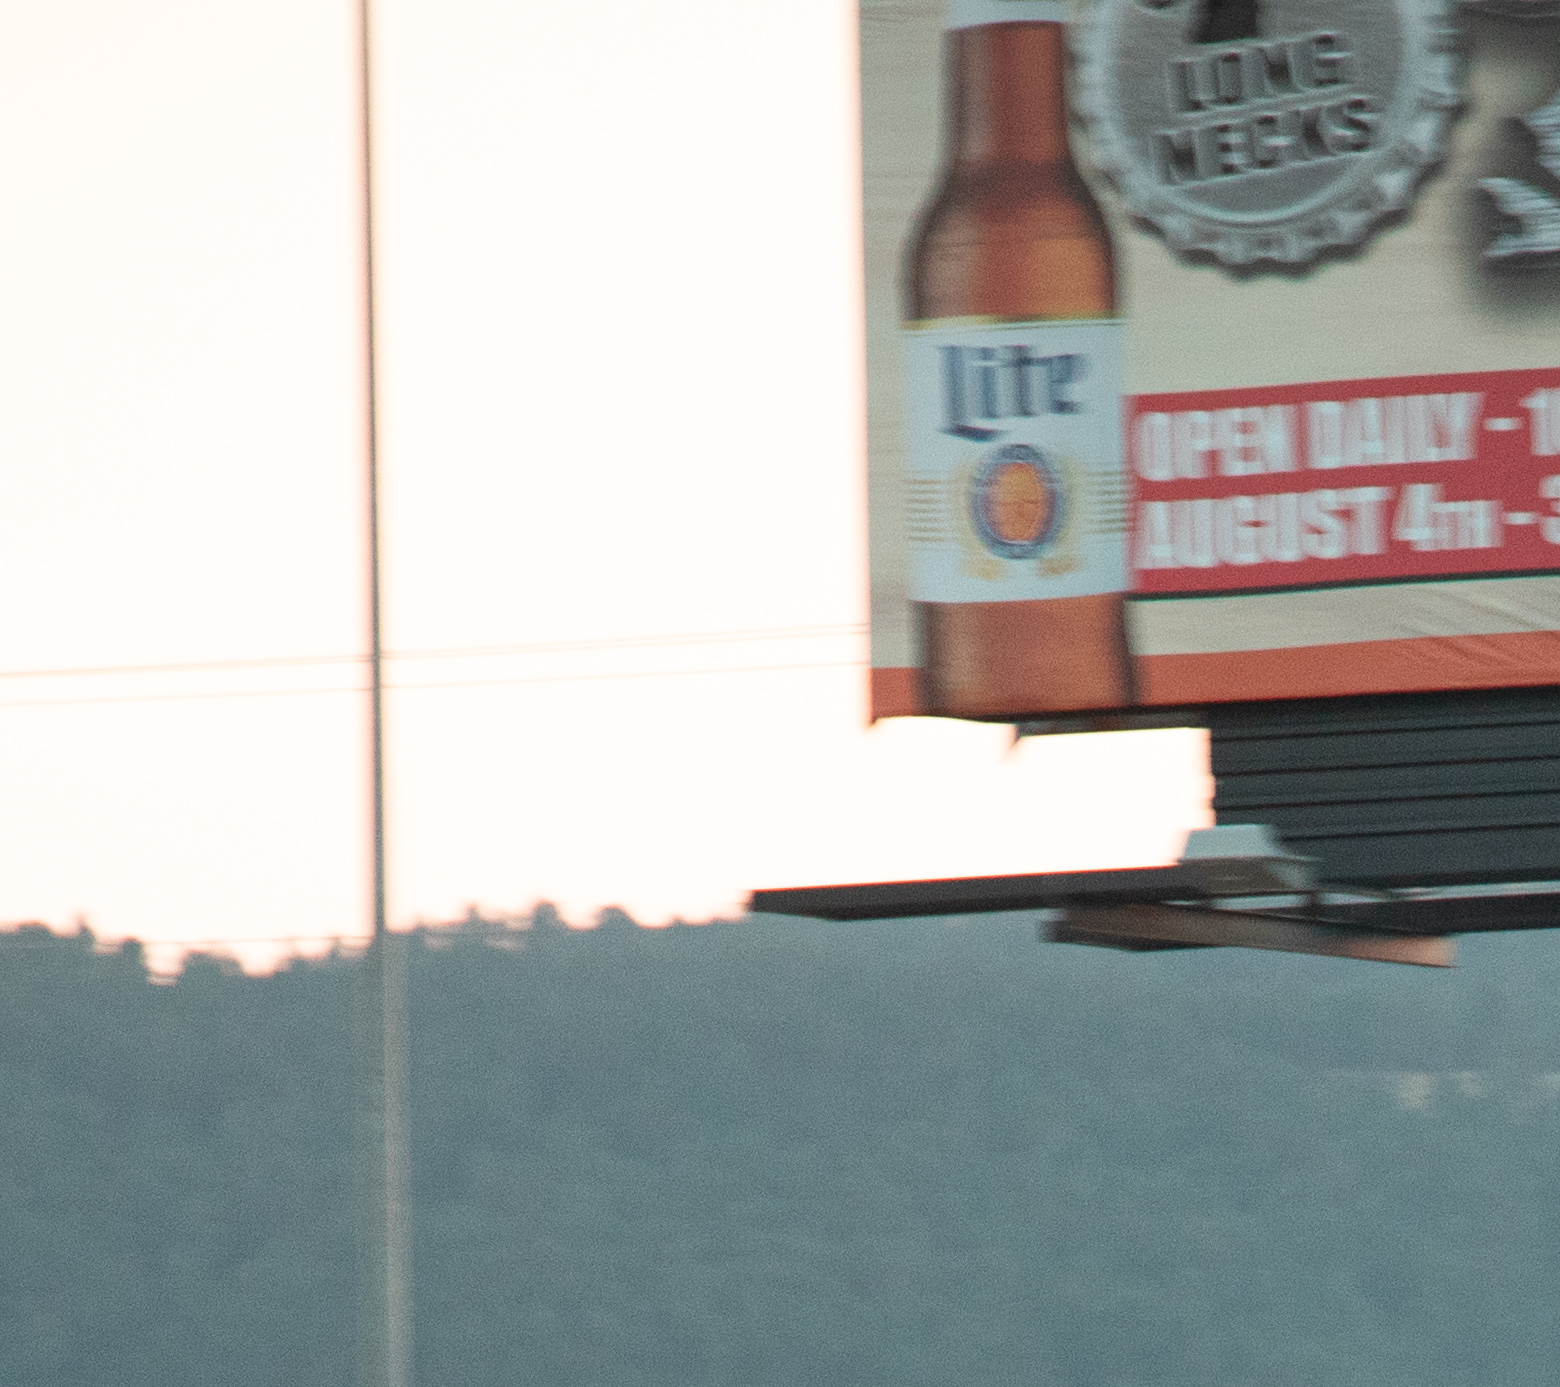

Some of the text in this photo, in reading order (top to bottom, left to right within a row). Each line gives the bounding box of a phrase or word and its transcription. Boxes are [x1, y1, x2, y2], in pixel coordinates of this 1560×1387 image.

[1169, 30, 1352, 118] LONG
[1154, 93, 1380, 187] NECKS
[939, 344, 1086, 442] Lite
[1134, 404, 1300, 482] OPEN
[1306, 391, 1485, 471] DAILY
[1137, 485, 1395, 570] AUGUST
